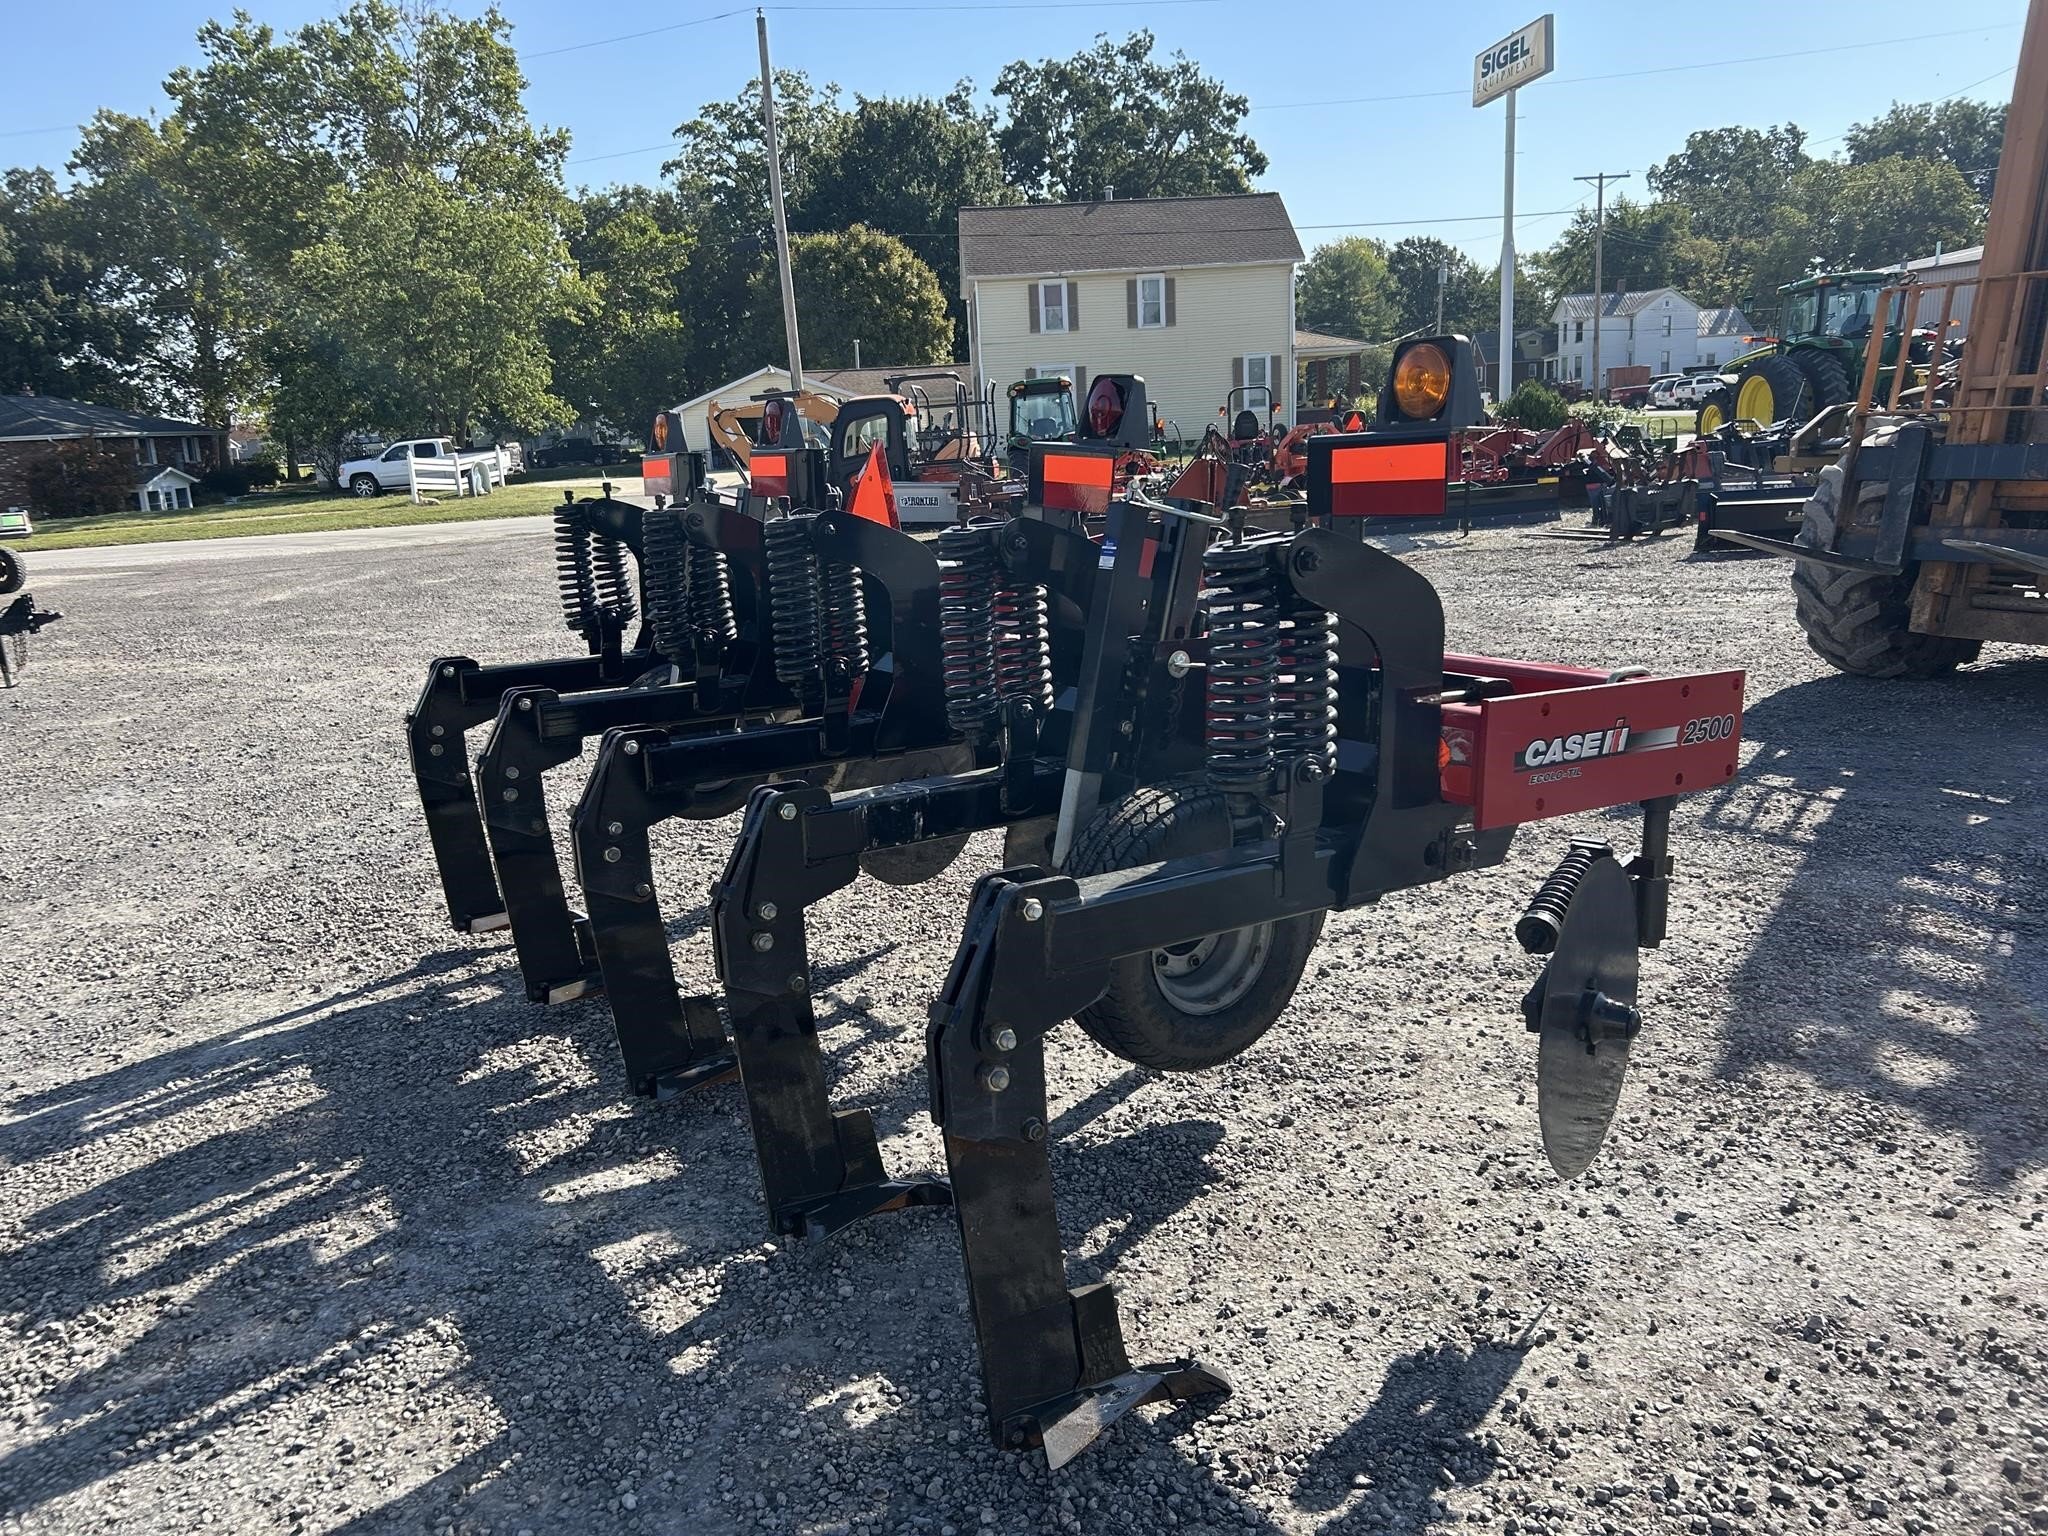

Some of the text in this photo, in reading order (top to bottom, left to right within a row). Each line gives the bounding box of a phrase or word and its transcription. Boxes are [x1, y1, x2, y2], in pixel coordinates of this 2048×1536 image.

[1481, 35, 1530, 79] SIGEL
[1476, 54, 1535, 94] EQUIPMENT
[908, 496, 939, 507] FRONTIER
[1681, 714, 1735, 746] 2500
[1529, 767, 1582, 785] ECOLO-TIL
